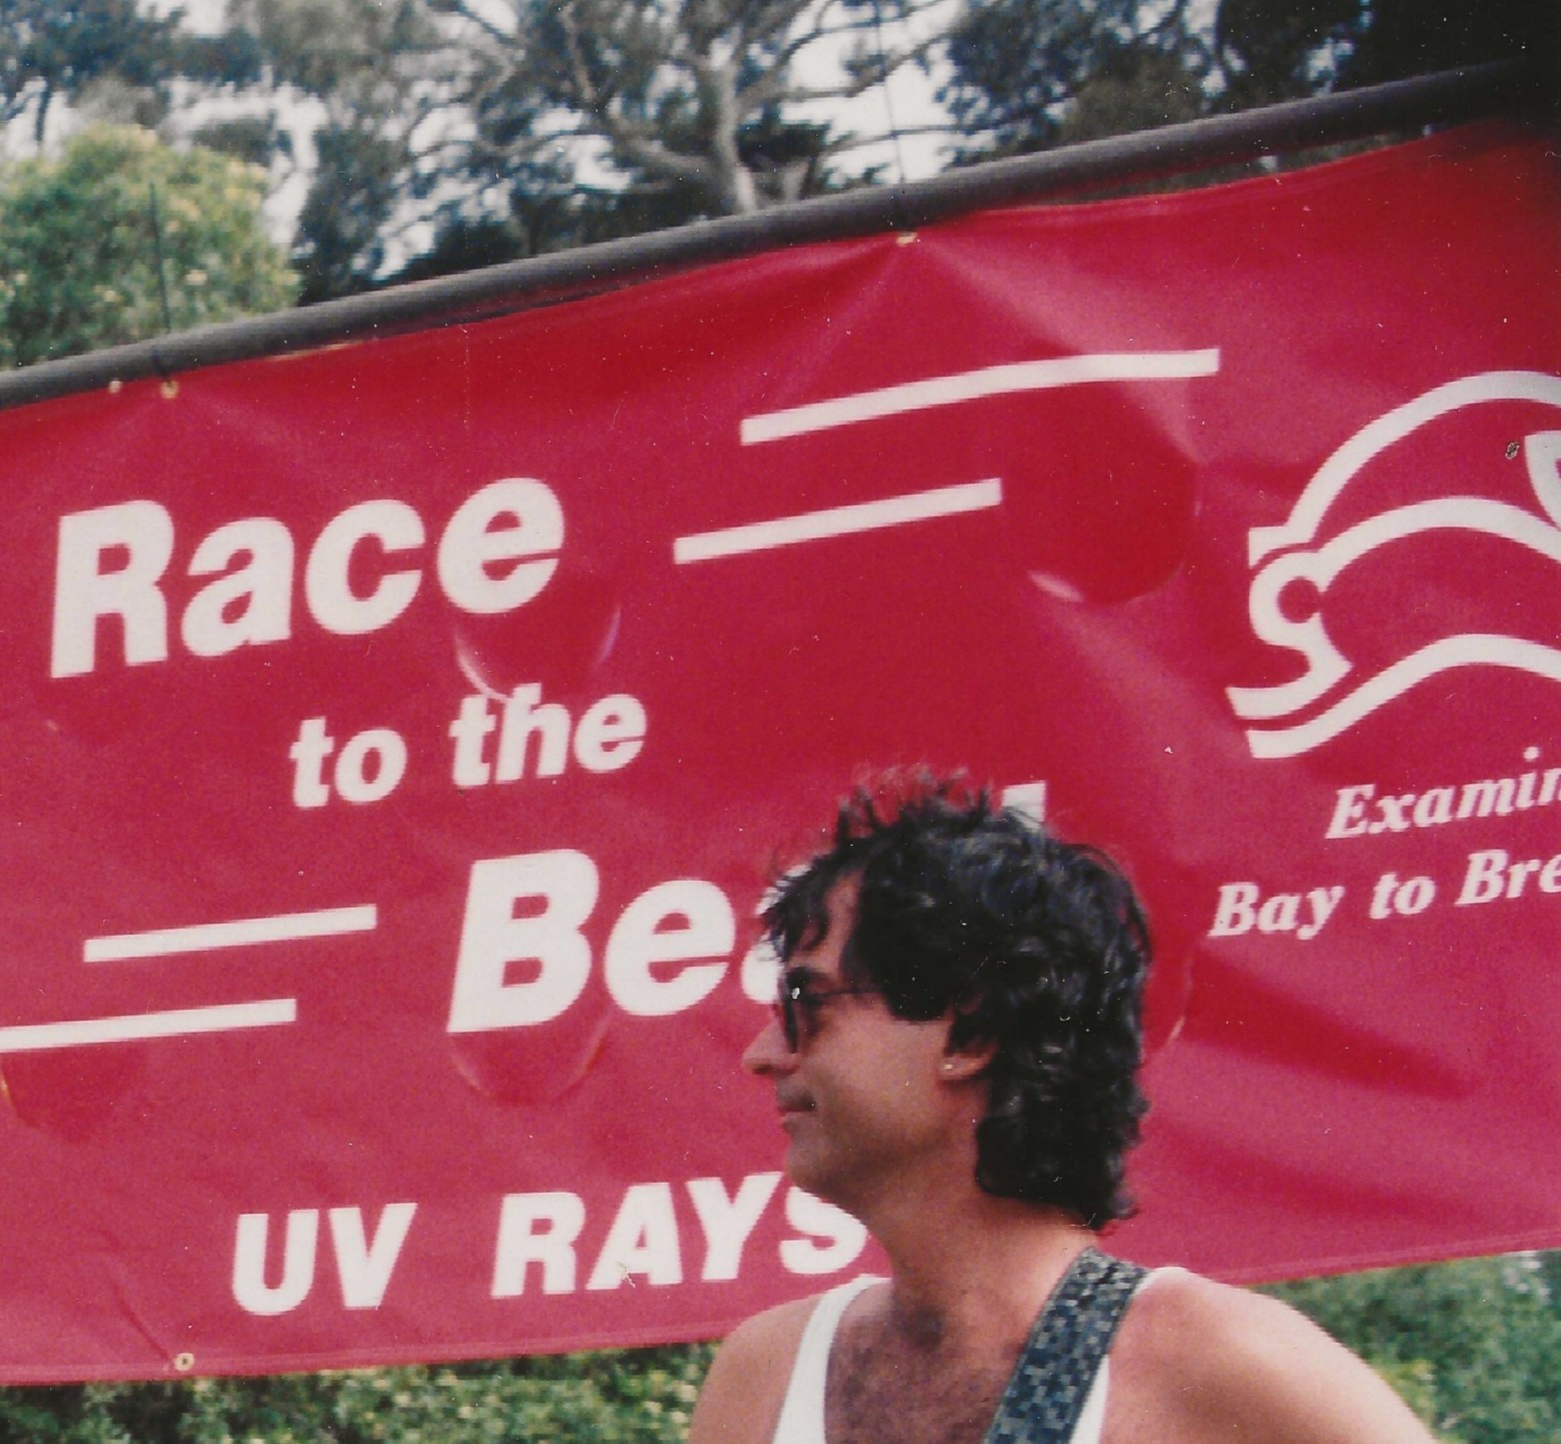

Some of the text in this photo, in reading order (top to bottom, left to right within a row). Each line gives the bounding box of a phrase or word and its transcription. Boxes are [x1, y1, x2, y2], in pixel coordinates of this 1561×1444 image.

[50, 477, 565, 679] Race
[289, 683, 646, 808] to the
[1207, 881, 1345, 940] Bay
[1369, 871, 1436, 920] to
[231, 1170, 869, 1316] UV RAYS
